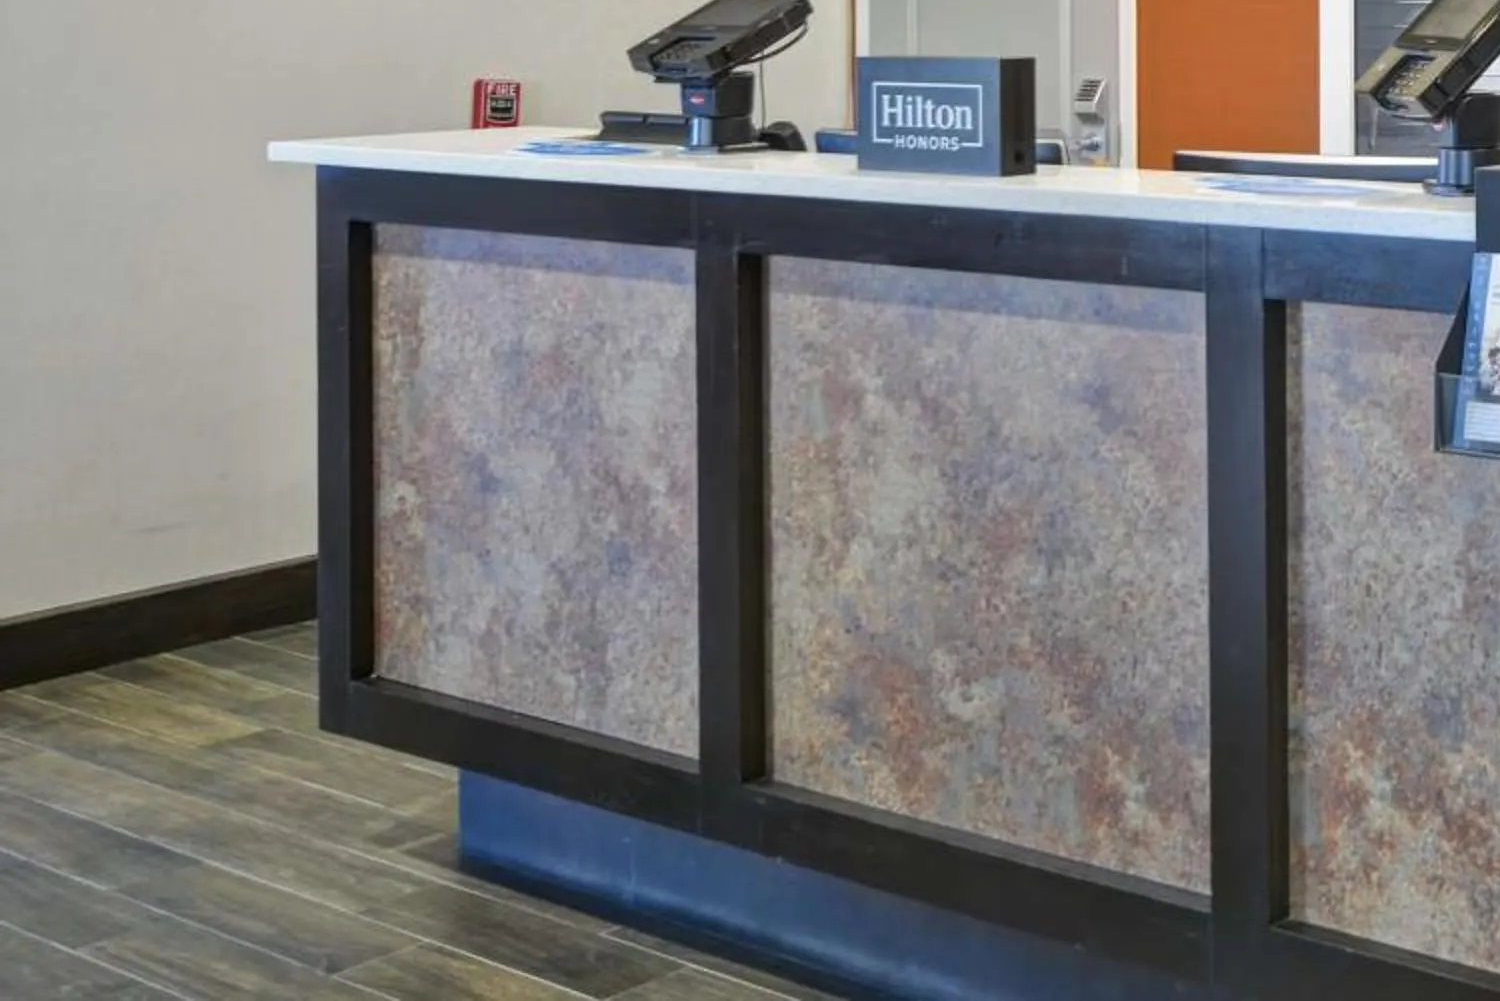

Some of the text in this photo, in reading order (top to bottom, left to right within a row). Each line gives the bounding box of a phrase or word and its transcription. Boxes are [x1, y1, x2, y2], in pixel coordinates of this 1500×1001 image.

[487, 83, 517, 96] FIRE
[881, 94, 974, 130] Hilton
[894, 134, 961, 152] HONORS
